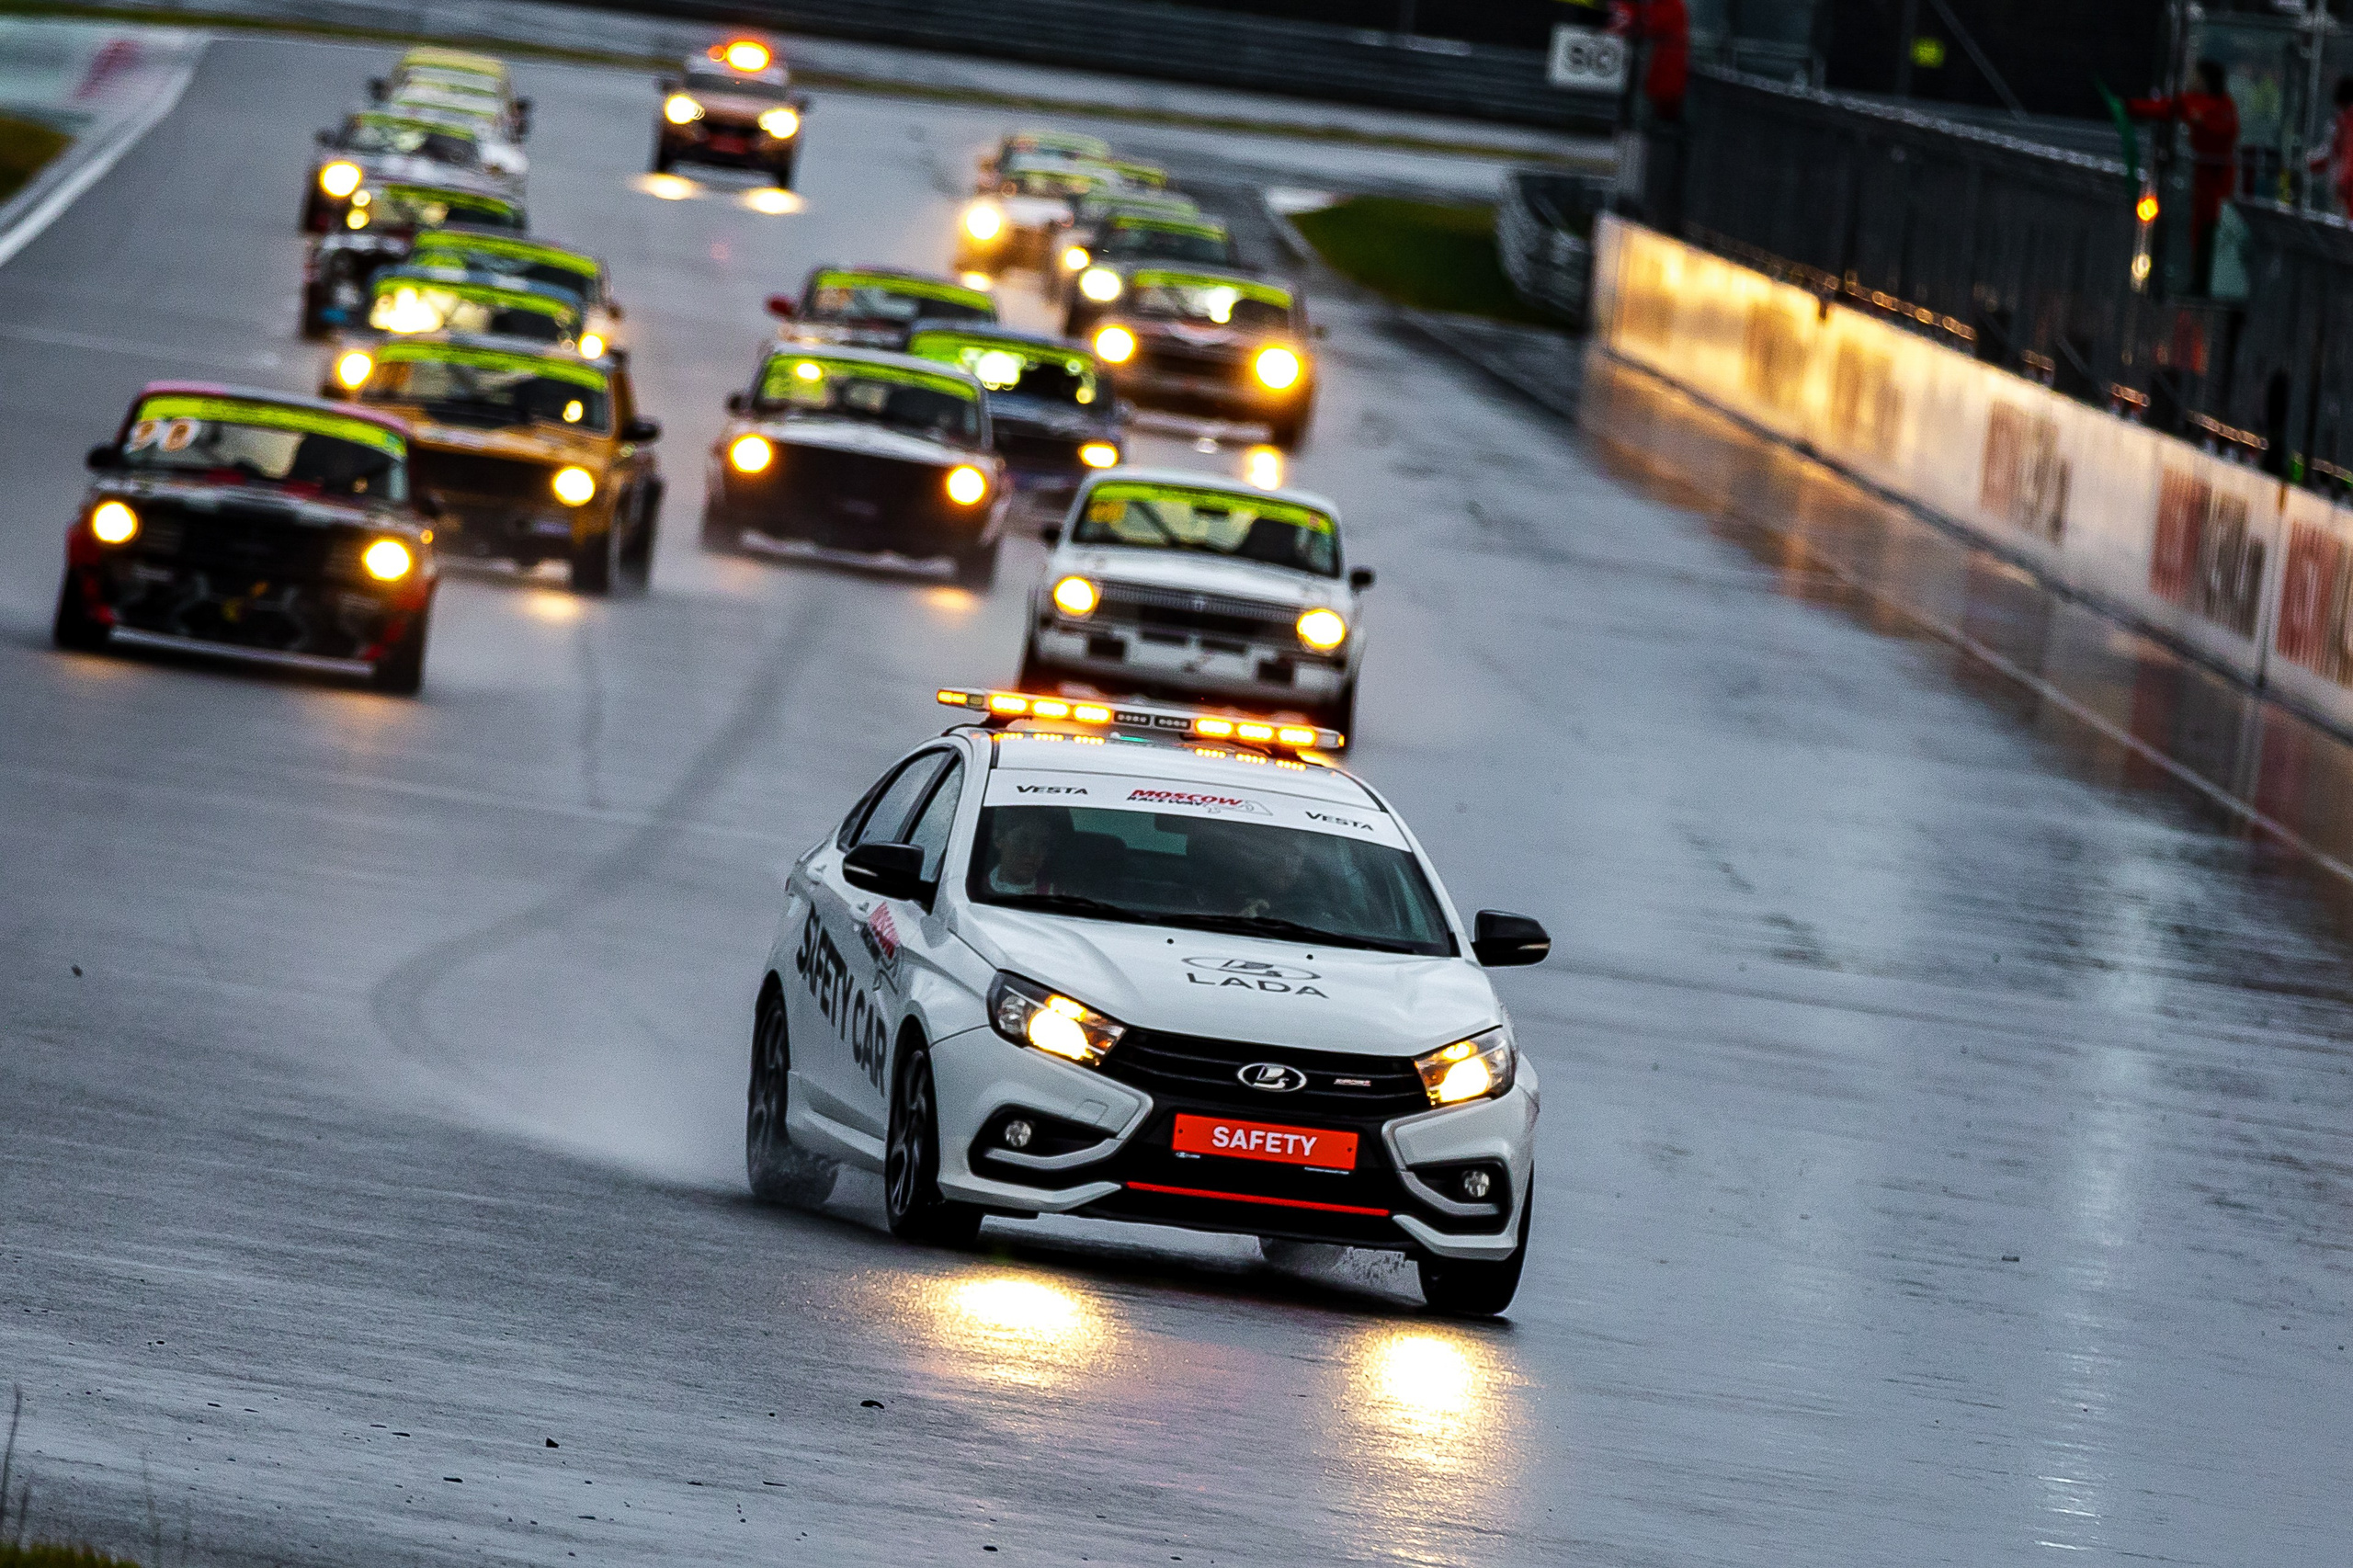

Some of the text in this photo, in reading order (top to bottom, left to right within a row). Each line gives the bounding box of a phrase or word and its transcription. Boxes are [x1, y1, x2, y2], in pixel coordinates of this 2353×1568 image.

[1017, 785, 1088, 795] VESTA
[1131, 789, 1243, 806] MOSCOW
[1305, 811, 1374, 832] VESTA
[1187, 972, 1330, 1000] LADA
[796, 900, 855, 1041] SAFETY
[852, 988, 887, 1098] CAR
[1211, 1126, 1318, 1157] SAFETY
